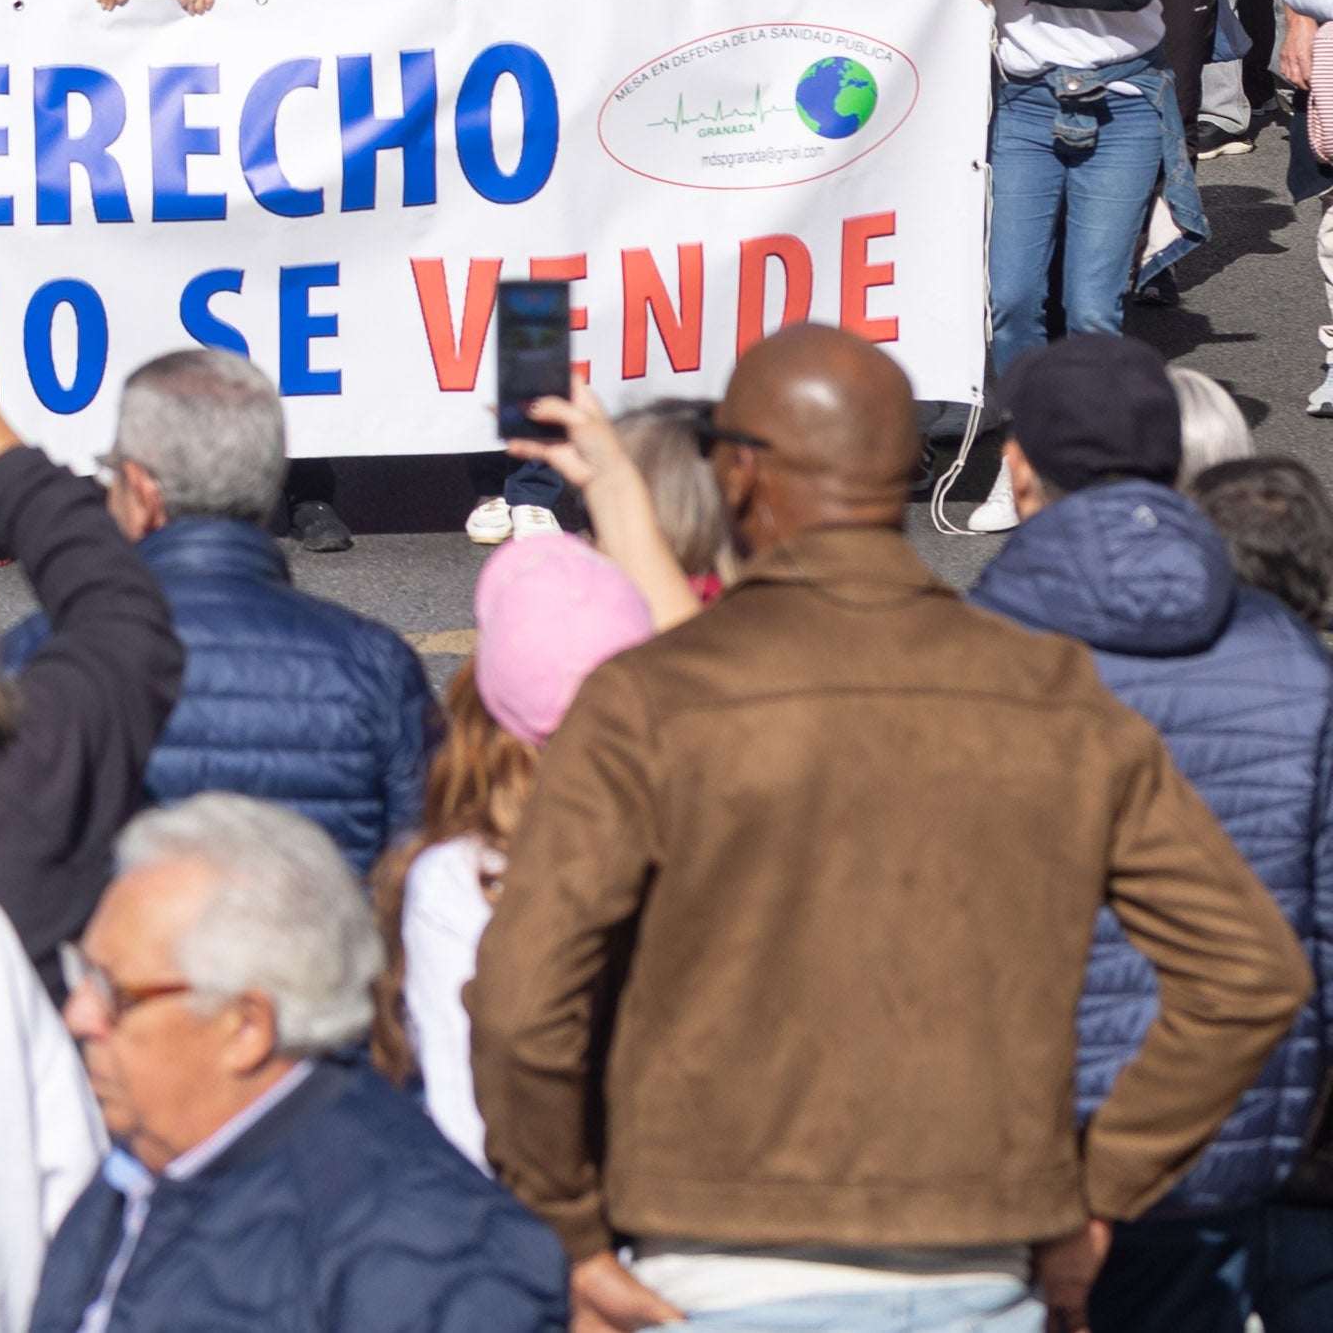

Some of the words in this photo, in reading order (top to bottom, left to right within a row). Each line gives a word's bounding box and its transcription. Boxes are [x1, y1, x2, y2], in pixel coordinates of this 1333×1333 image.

[614, 72, 650, 102] MESA
[652, 61, 670, 78] EN
[672, 39, 730, 68] DEFENSA
[732, 34, 748, 48] DE
[750, 29, 767, 42] LA
[770, 27, 833, 45] SANIDAD
[697, 124, 755, 139] GRANADA
[701, 145, 825, 168] mdspgranada@gmail.com
[179, 262, 342, 396] SE
